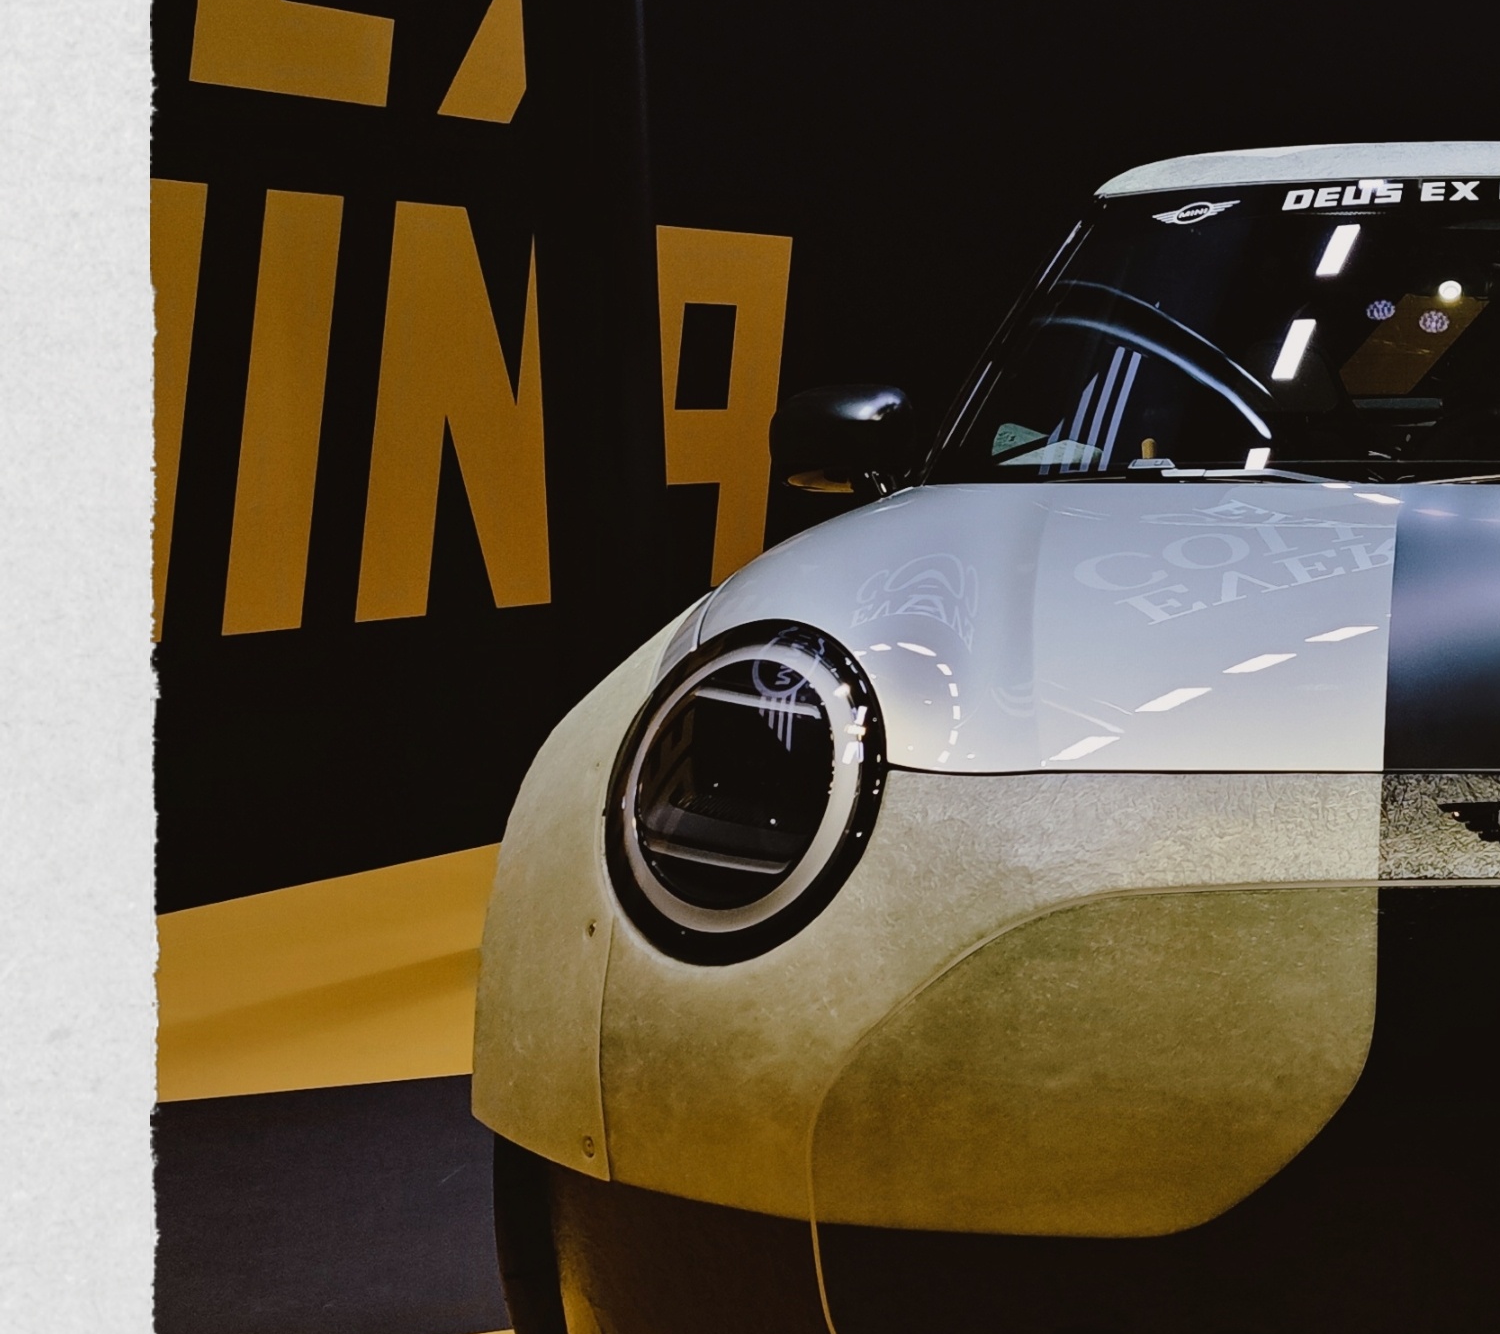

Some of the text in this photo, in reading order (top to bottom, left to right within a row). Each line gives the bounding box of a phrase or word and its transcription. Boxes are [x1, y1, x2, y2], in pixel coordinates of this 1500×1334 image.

[1281, 182, 1403, 211] DEUS
[1420, 181, 1480, 202] EX
[1178, 207, 1209, 219] MINI
